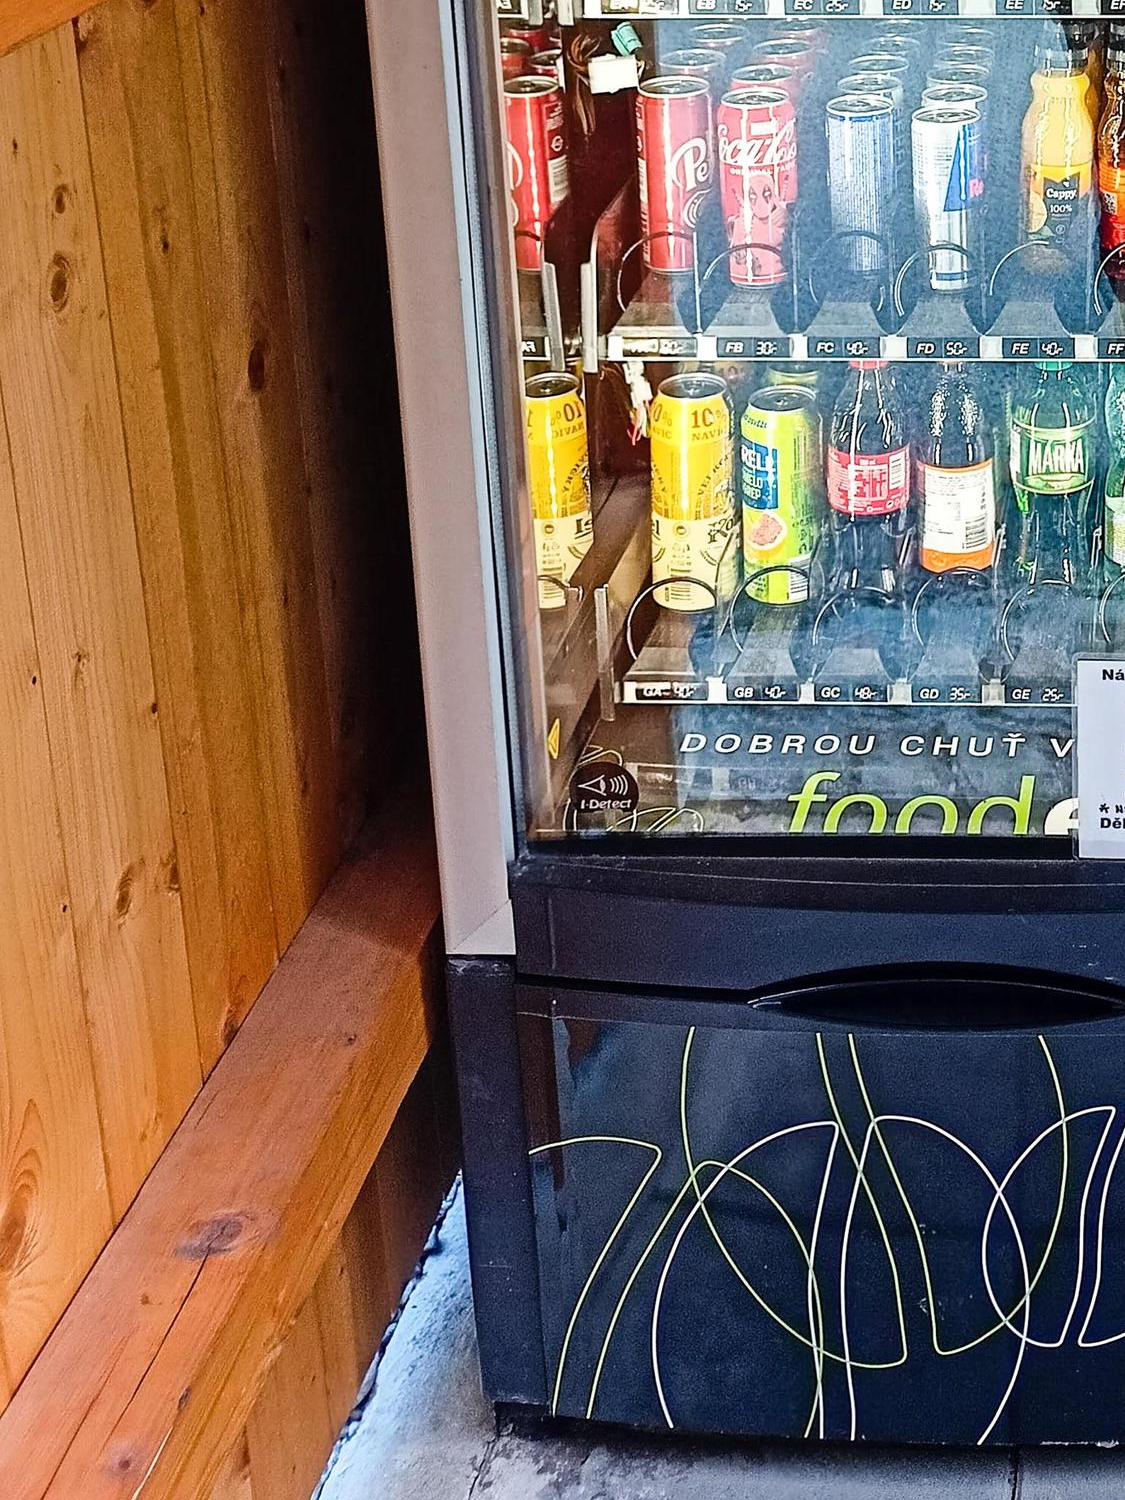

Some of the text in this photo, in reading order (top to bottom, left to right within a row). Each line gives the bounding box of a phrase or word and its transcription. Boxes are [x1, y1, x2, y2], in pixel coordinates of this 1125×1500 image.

[1046, 188, 1077, 200] Cappy
[1050, 204, 1073, 213] 100%
[725, 342, 744, 353] FB
[815, 342, 834, 353] FC
[916, 342, 935, 353] FD
[1011, 342, 1030, 354] FE
[1107, 343, 1125, 354] FF
[643, 686, 663, 697] GA
[734, 686, 754, 698] GB
[820, 686, 841, 698] GC
[919, 688, 940, 699] GD
[1012, 688, 1031, 700] GE
[680, 732, 1028, 757] DOBROU CHUŤ
